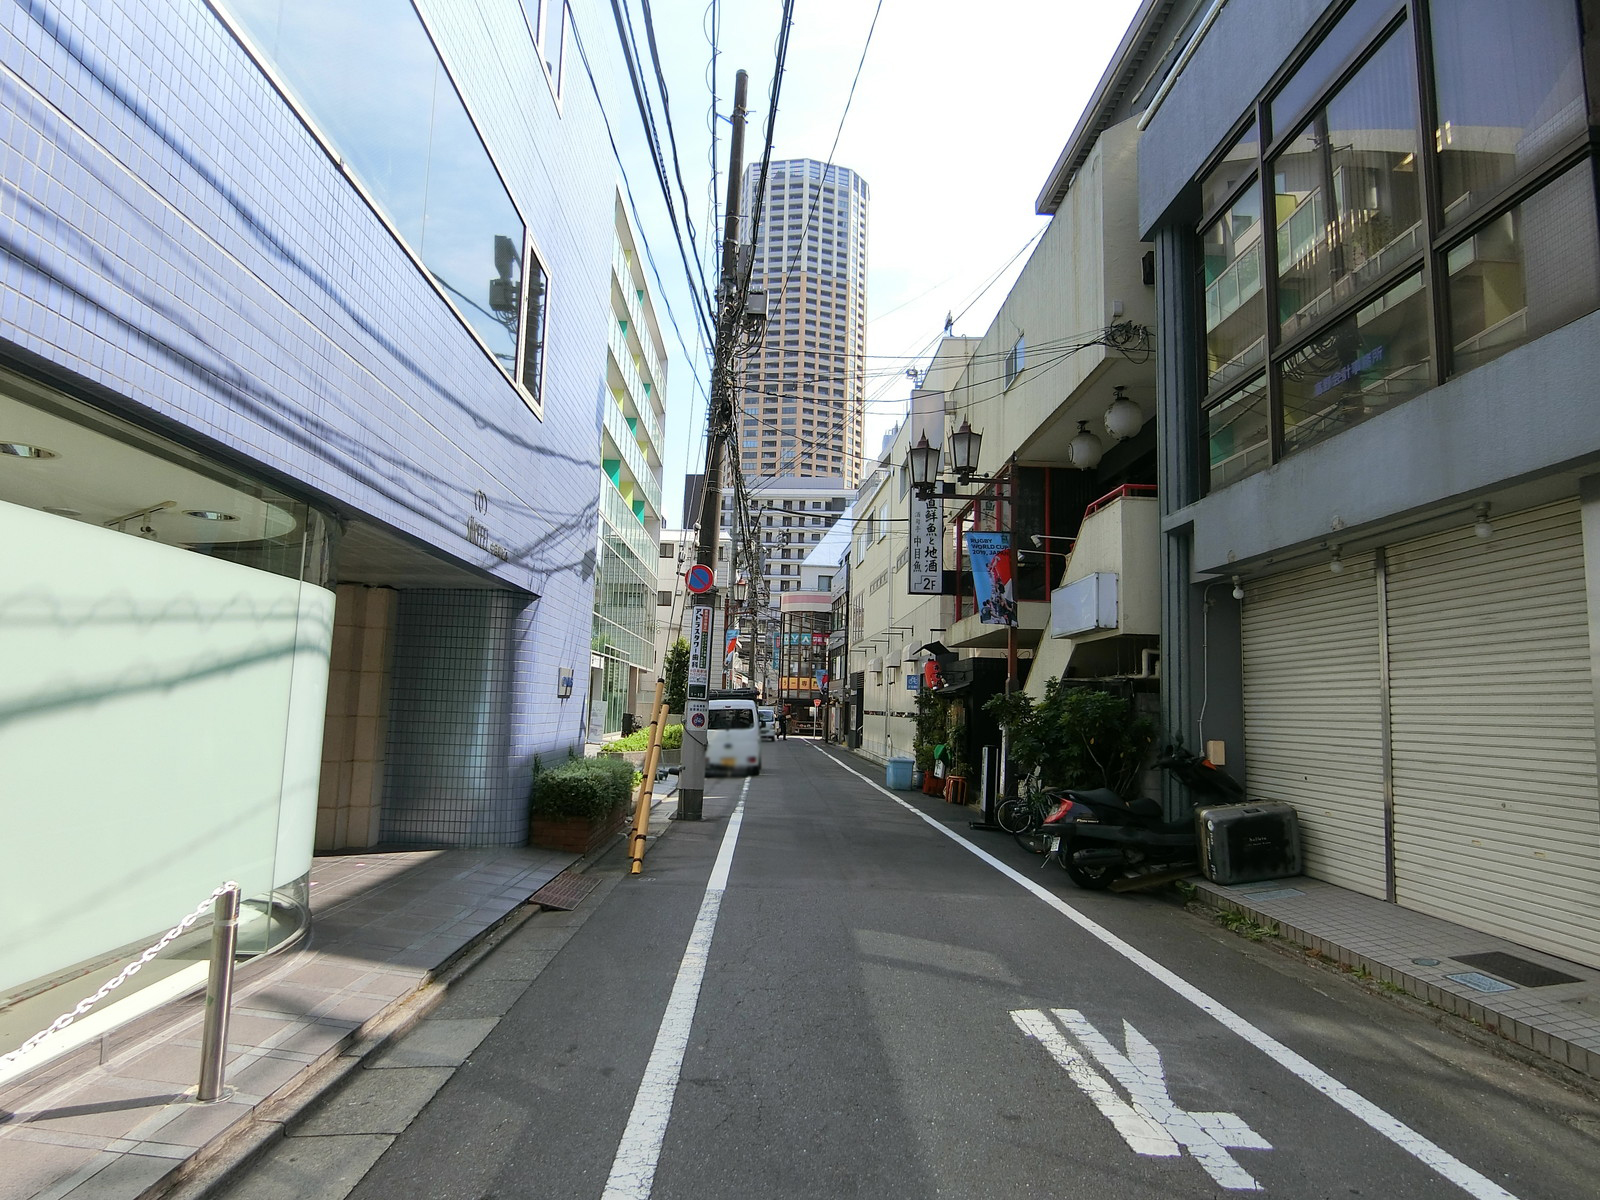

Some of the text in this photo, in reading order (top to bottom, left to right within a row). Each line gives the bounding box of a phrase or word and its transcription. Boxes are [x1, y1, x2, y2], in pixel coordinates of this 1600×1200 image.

[913, 535, 922, 573] 中目魚
[925, 487, 938, 573] 直鮮魚と地酒
[923, 577, 936, 590] 2F
[692, 608, 703, 669] アトラスタワー歯科
